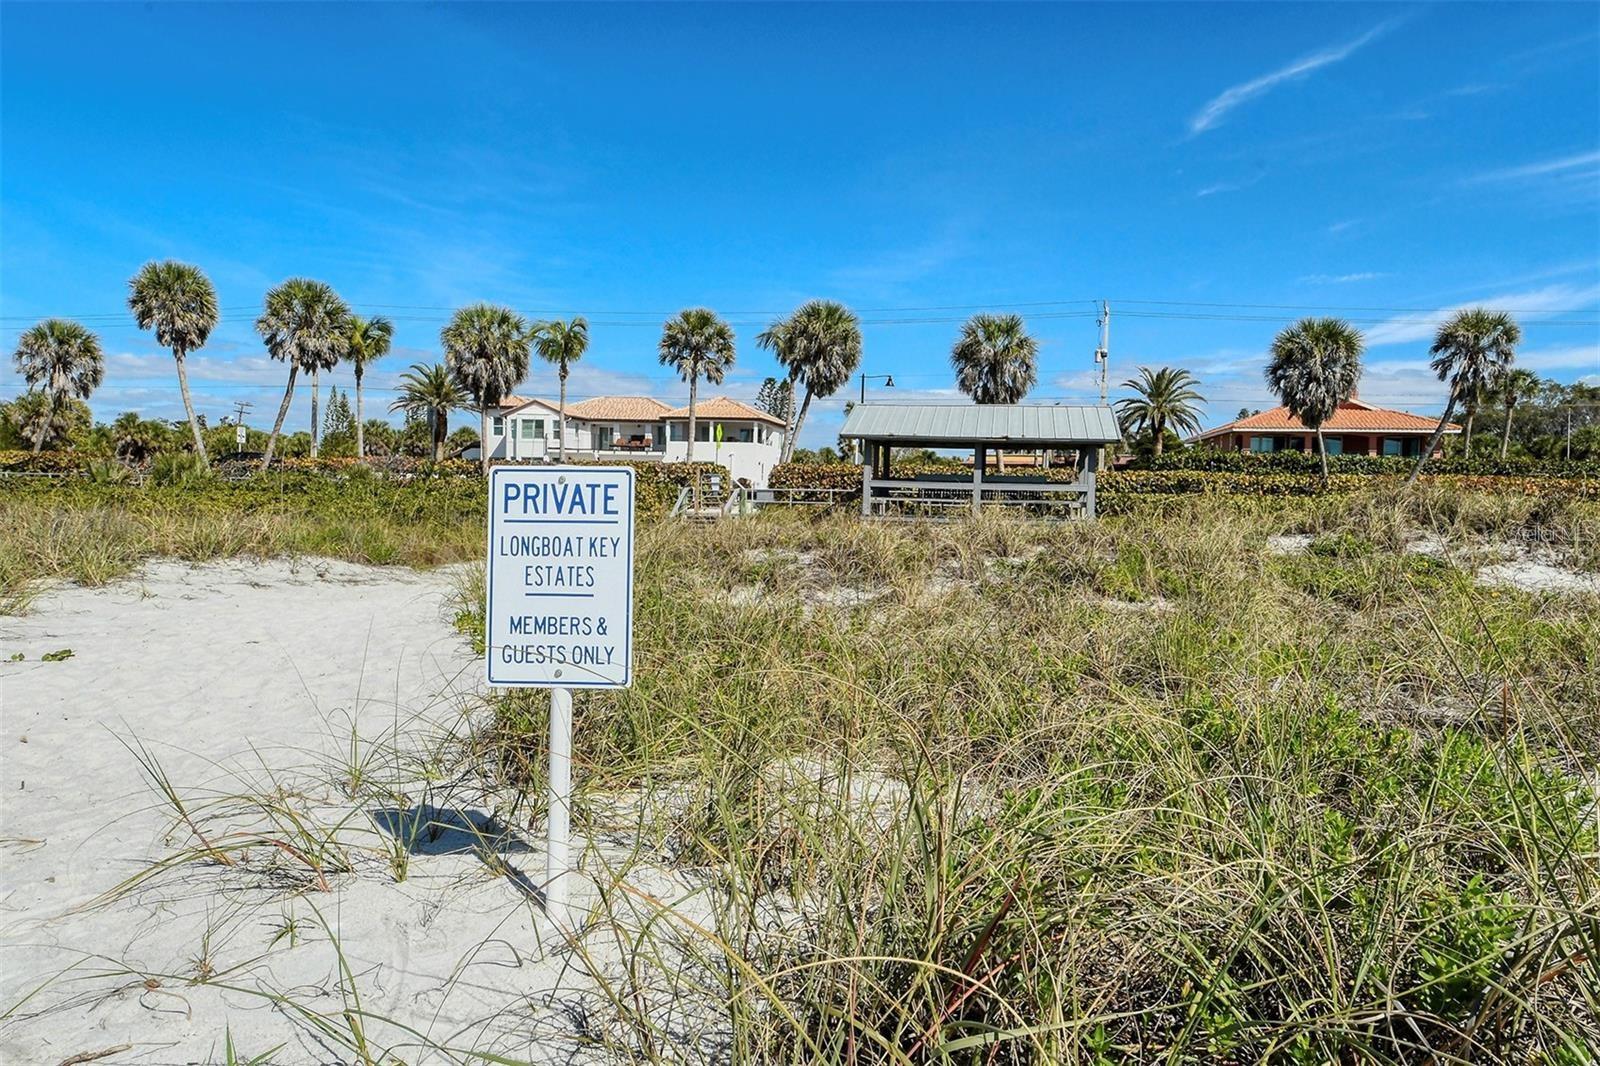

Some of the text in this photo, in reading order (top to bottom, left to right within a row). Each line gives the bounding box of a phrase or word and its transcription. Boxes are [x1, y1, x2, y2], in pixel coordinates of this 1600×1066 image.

[503, 483, 619, 515] PRIVATE
[500, 535, 620, 557] LONGBOAT KEY
[525, 565, 595, 587] ESTATES
[509, 615, 608, 636] MEMBERS &
[502, 644, 615, 665] GUESTS ONLY
